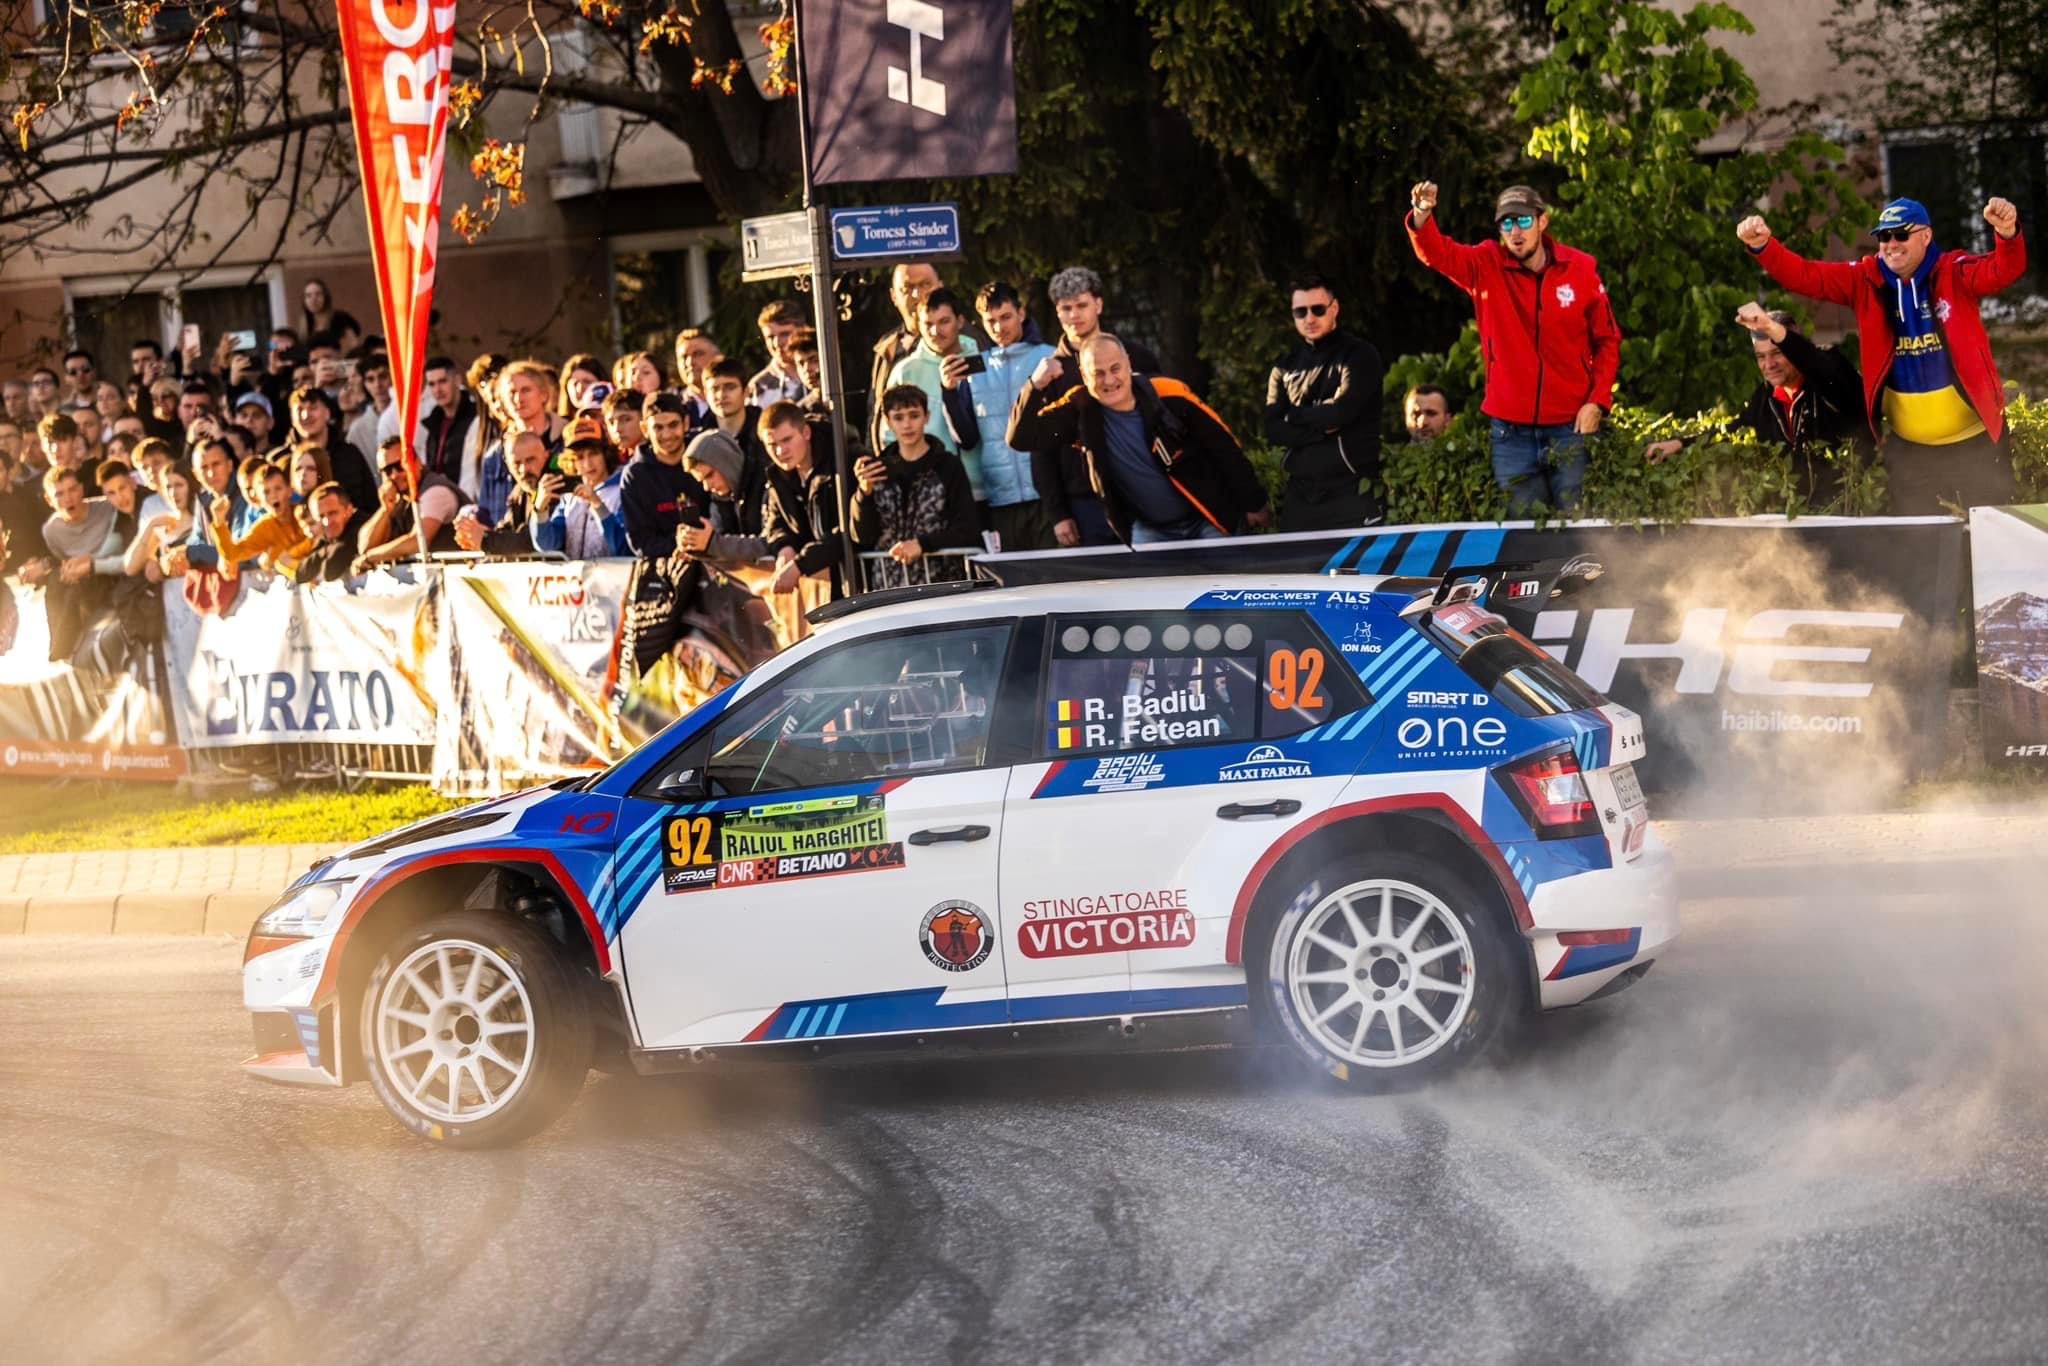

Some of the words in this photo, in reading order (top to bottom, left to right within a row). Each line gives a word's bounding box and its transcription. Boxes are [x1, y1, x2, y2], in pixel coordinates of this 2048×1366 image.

[861, 224, 906, 240] Tomcsa
[908, 221, 949, 237] Sándor
[1243, 592, 1319, 601] ROCK-WEST
[1326, 603, 1369, 611] BETON
[1341, 643, 1359, 653] ION
[1360, 644, 1382, 654] MOS
[1268, 647, 1325, 711] 92
[1084, 698, 1113, 721] R.
[1123, 690, 1207, 719] Badiu
[1473, 693, 1489, 706] ID
[1085, 724, 1114, 748] R.
[1123, 716, 1221, 744] Fetean
[1721, 710, 1862, 735] haibike.com
[1098, 752, 1156, 769] BADIU
[1397, 751, 1437, 759] UNITED
[1442, 749, 1508, 757] PROPERTIES
[1092, 763, 1165, 780] RACING
[1218, 767, 1261, 782] MAXI
[1261, 764, 1312, 779] FARMA
[668, 816, 713, 868] 92
[725, 834, 788, 858] RALIUL
[792, 817, 885, 851] HARGHITEI
[678, 867, 717, 881] FRAS
[720, 861, 755, 884] CNR
[778, 851, 847, 875] BETANO
[1022, 888, 1189, 920] STINGATOARE
[1026, 911, 1193, 952] VICTORIA
[926, 949, 989, 973] PROTECTION
